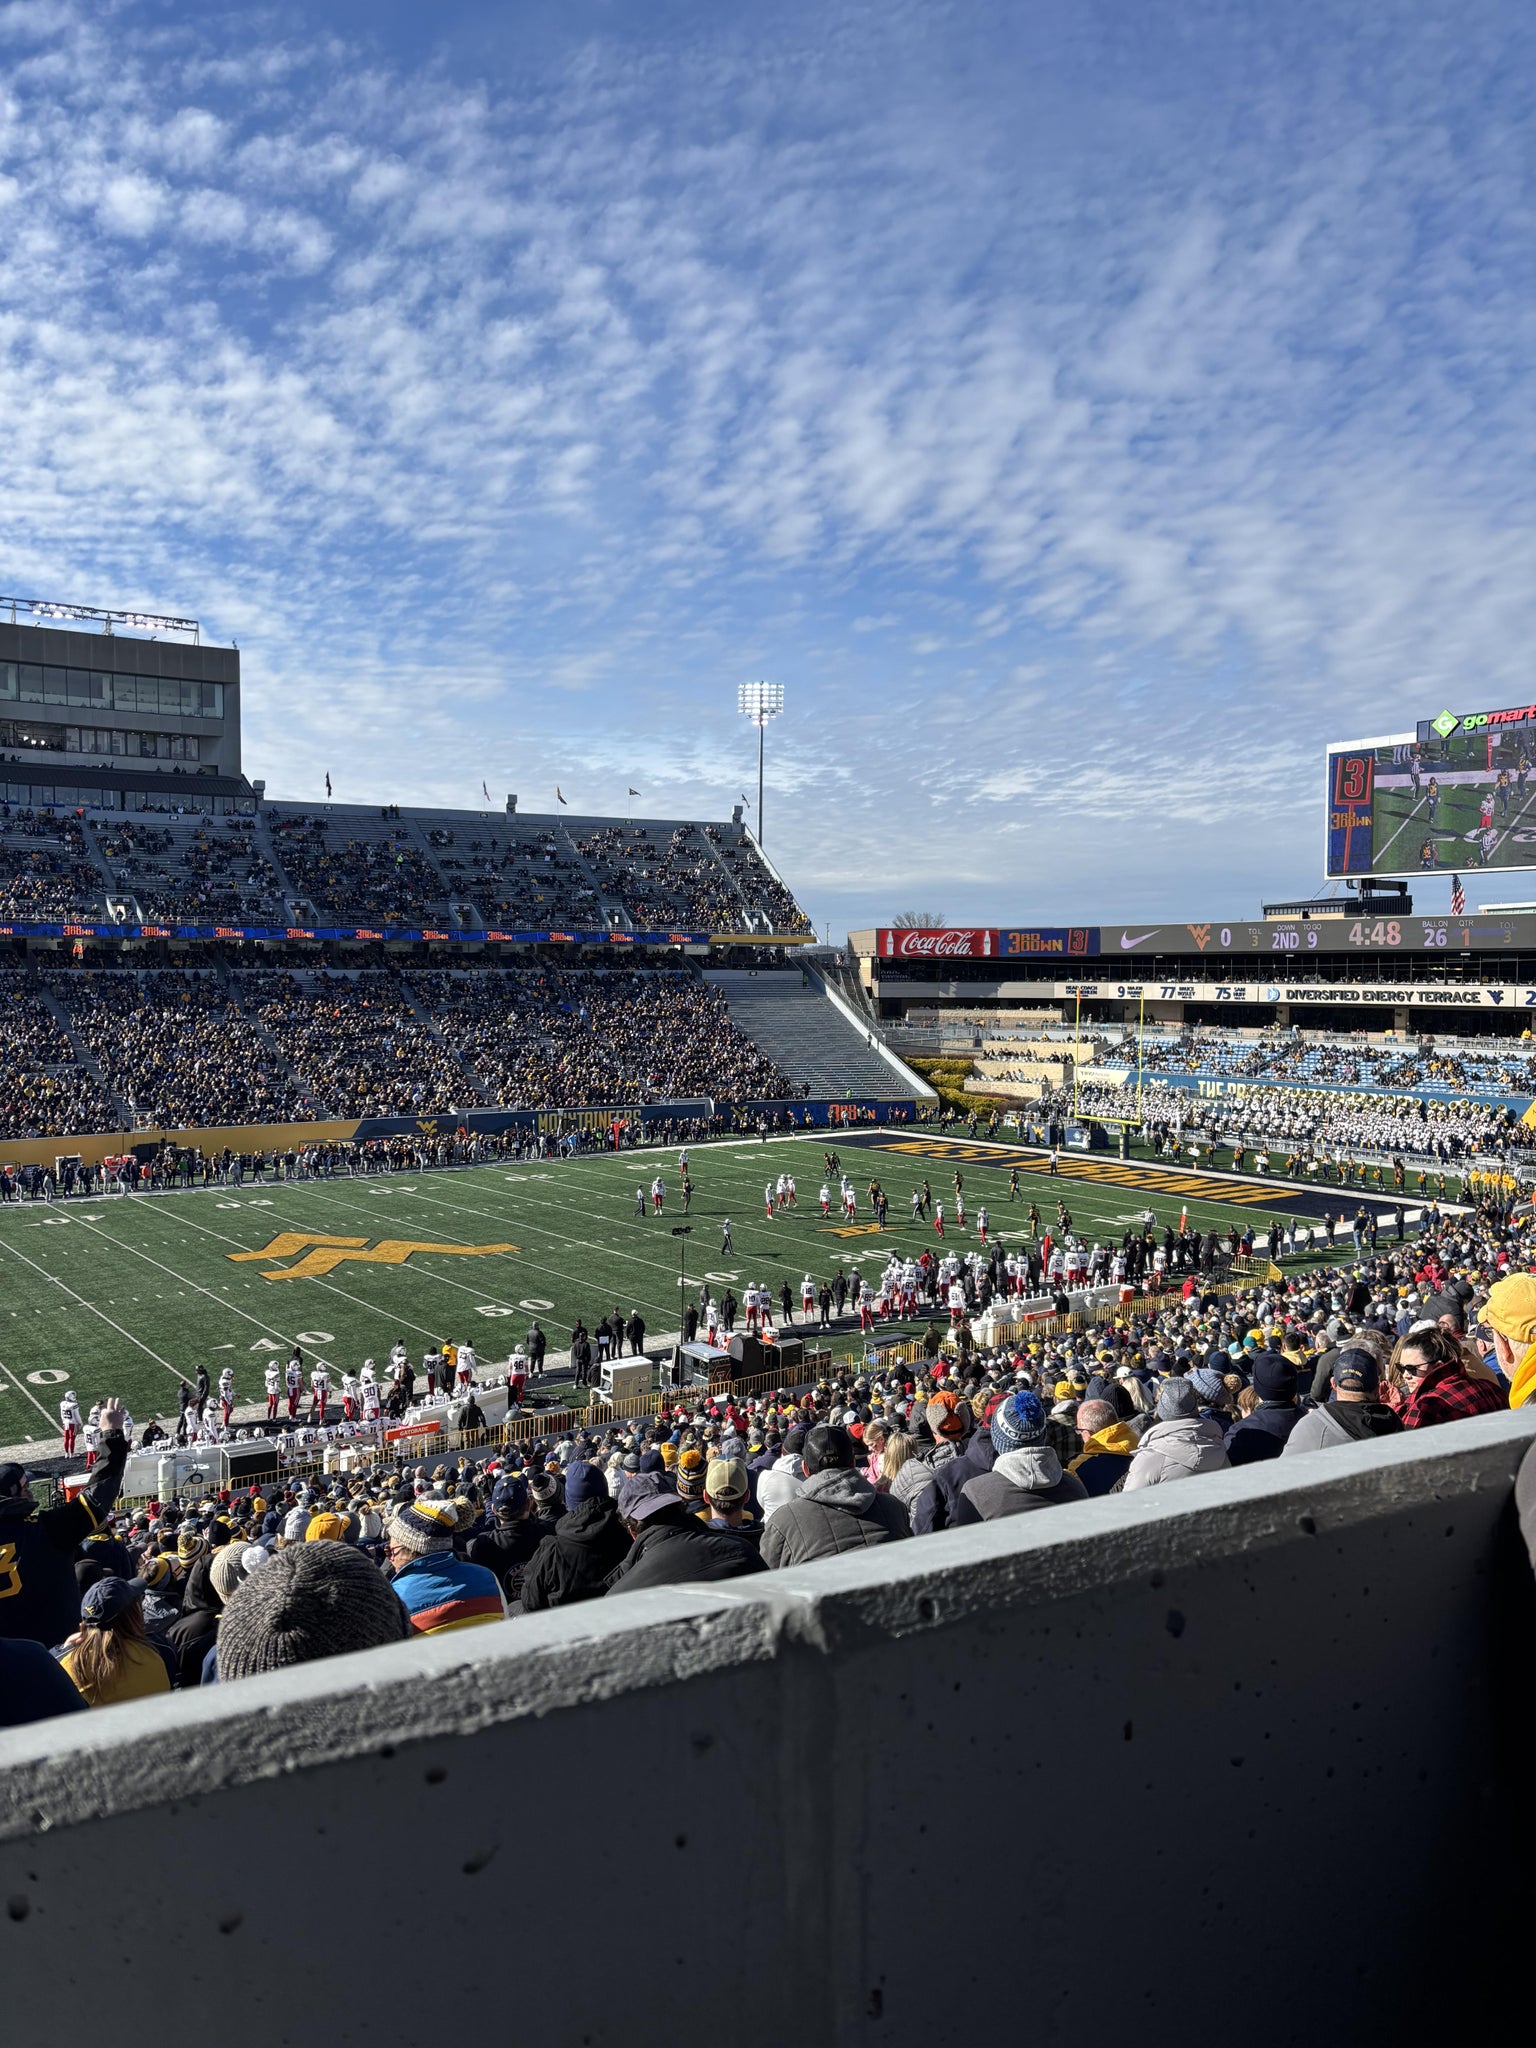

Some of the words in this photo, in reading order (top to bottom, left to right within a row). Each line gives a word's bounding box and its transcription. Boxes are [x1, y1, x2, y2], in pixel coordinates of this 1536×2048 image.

[1463, 705, 1536, 730] gomart
[1422, 920, 1438, 928] BALL
[1459, 919, 1474, 927] QTR
[1220, 928, 1231, 947] 0
[1308, 931, 1318, 949] 9
[1349, 921, 1401, 946] 4:48
[1424, 928, 1448, 947] 26
[1461, 928, 1470, 947] 1
[1504, 929, 1512, 943] 3
[900, 931, 974, 955] Coca-Cola
[1252, 935, 1258, 946] 3
[1272, 932, 1300, 949] 2ND
[1117, 985, 1126, 998] 9
[1160, 986, 1176, 998] 77
[1215, 987, 1231, 1000] 75
[1286, 989, 1360, 1001] DIVERSIFIED
[1362, 990, 1415, 1003] ENERGY
[1416, 991, 1481, 1003] TERRACE
[473, 1299, 555, 1318] 50
[314, 1379, 325, 1389] 34
[363, 1386, 375, 1398] 90
[327, 1431, 334, 1442] 6
[348, 1425, 356, 1436] 3
[400, 1426, 429, 1437] GATORADE
[285, 1437, 295, 1449] 10
[302, 1433, 314, 1444] 40
